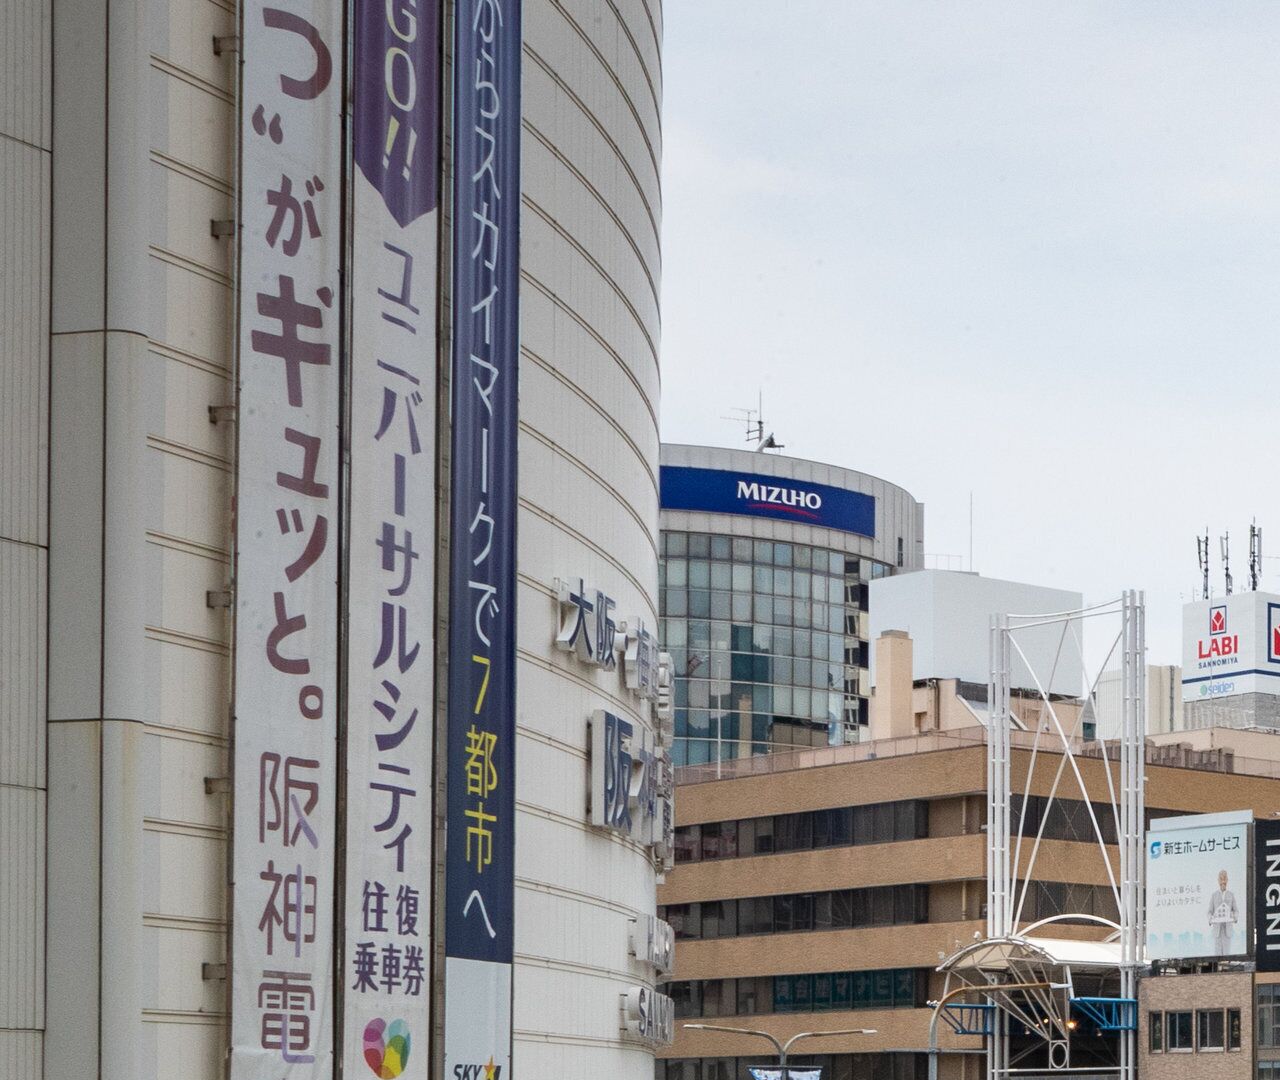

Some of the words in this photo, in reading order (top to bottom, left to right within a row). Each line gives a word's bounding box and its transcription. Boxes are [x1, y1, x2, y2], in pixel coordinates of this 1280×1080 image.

[737, 480, 822, 510] MIZUHO
[369, 240, 425, 873] ユニバーサルシティ
[1198, 635, 1239, 660] LABI
[1198, 657, 1239, 669] SANNOMIYA
[1163, 836, 1240, 856] 新生ホームサービス
[361, 879, 421, 935] 往復
[352, 942, 425, 996] 乗車券
